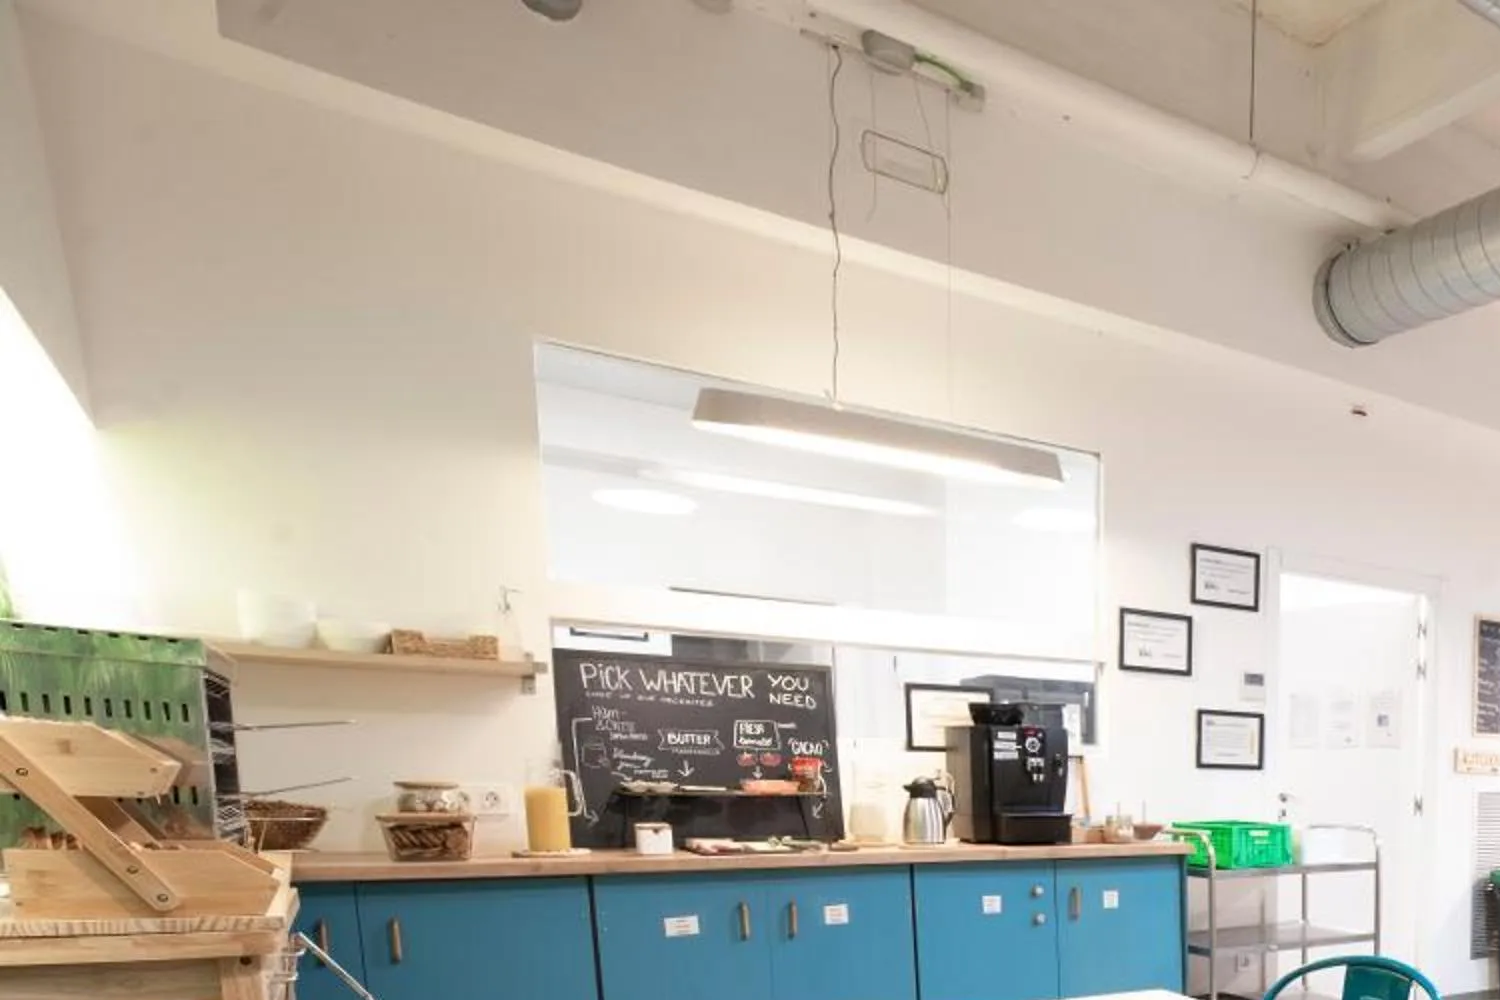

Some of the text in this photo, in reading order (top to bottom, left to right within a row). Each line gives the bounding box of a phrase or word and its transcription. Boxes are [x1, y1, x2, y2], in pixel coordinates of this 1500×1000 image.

[638, 668, 756, 699] WHATEVER
[767, 673, 810, 693] YOU
[769, 692, 818, 710] NEED
[666, 732, 711, 745] BUTTER
